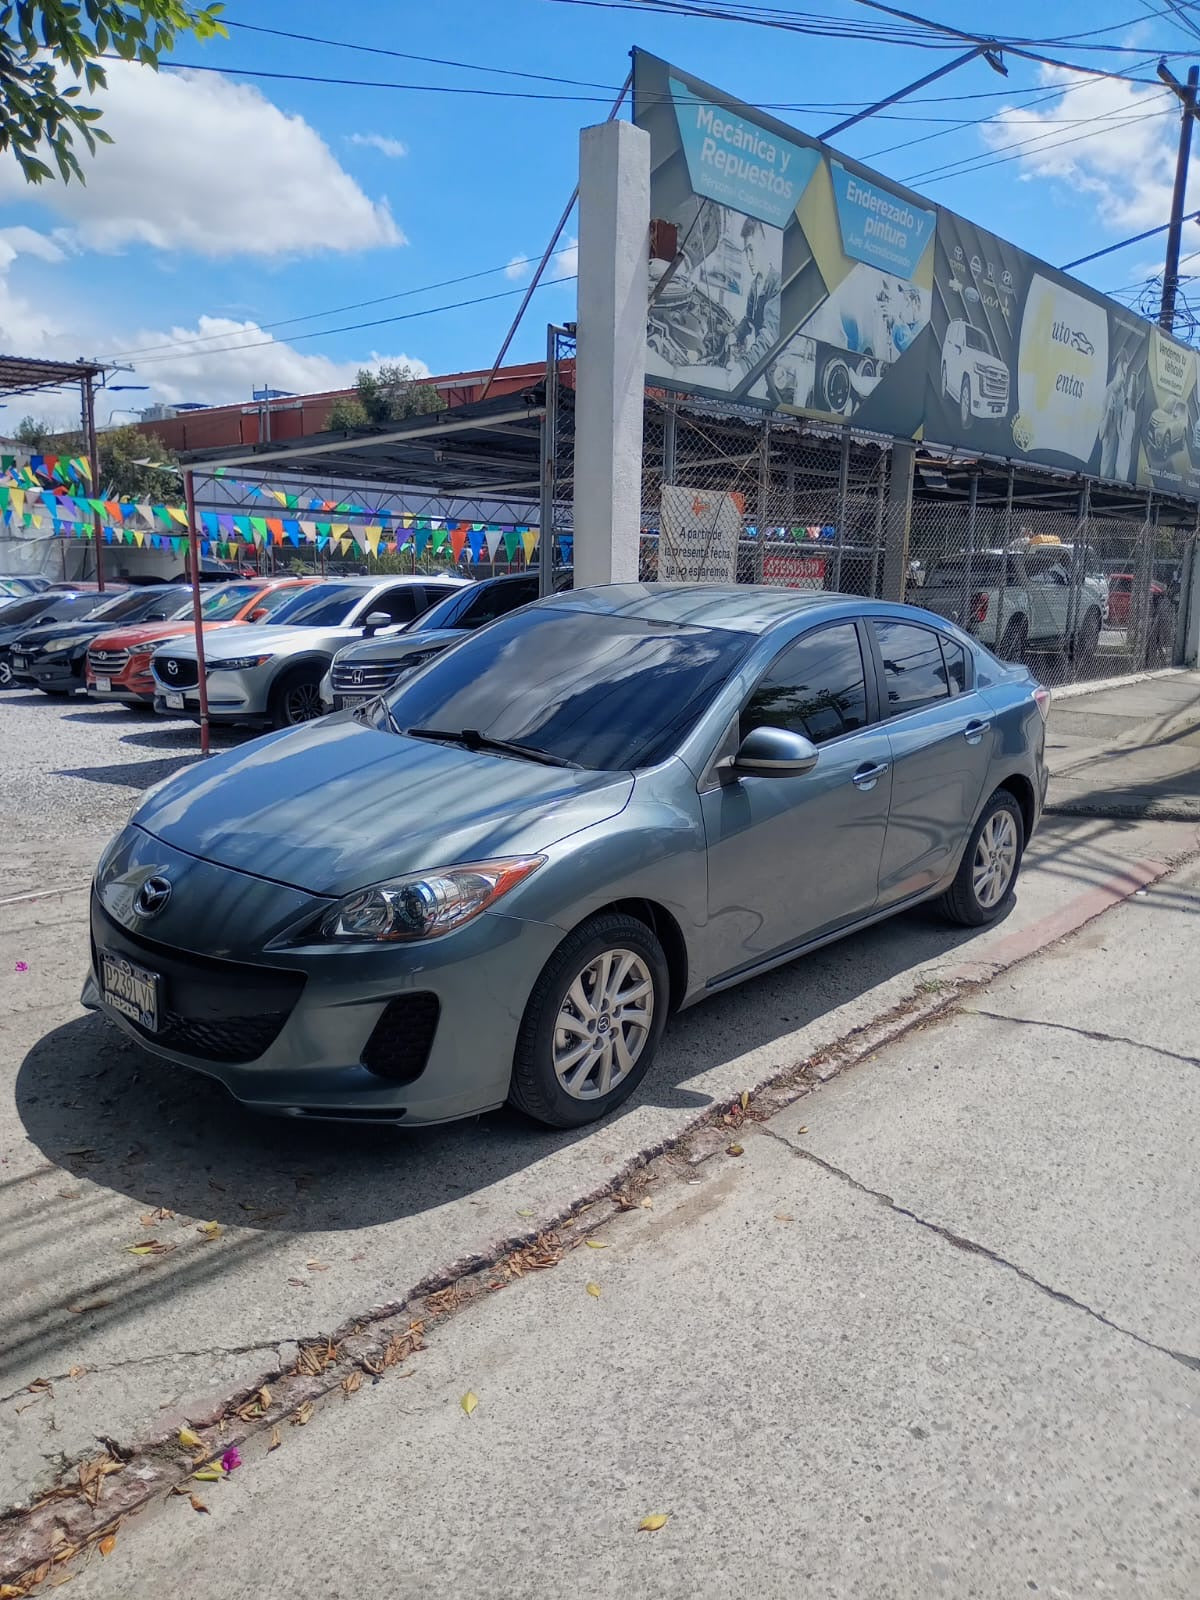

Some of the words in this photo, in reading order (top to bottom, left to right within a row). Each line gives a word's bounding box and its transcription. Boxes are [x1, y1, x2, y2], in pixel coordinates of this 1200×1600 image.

[696, 105, 776, 164] Mecánica
[780, 150, 791, 172] y
[701, 136, 793, 201] Repuestos
[846, 180, 914, 229] Enderezado
[914, 219, 925, 235] y
[863, 216, 907, 249] pintura
[1052, 321, 1070, 345] uto
[1055, 373, 1085, 399] entas
[680, 526, 686, 539] A
[687, 527, 711, 542] partir
[712, 529, 722, 541] de
[672, 547, 709, 560] presente
[688, 565, 729, 577] estaremos
